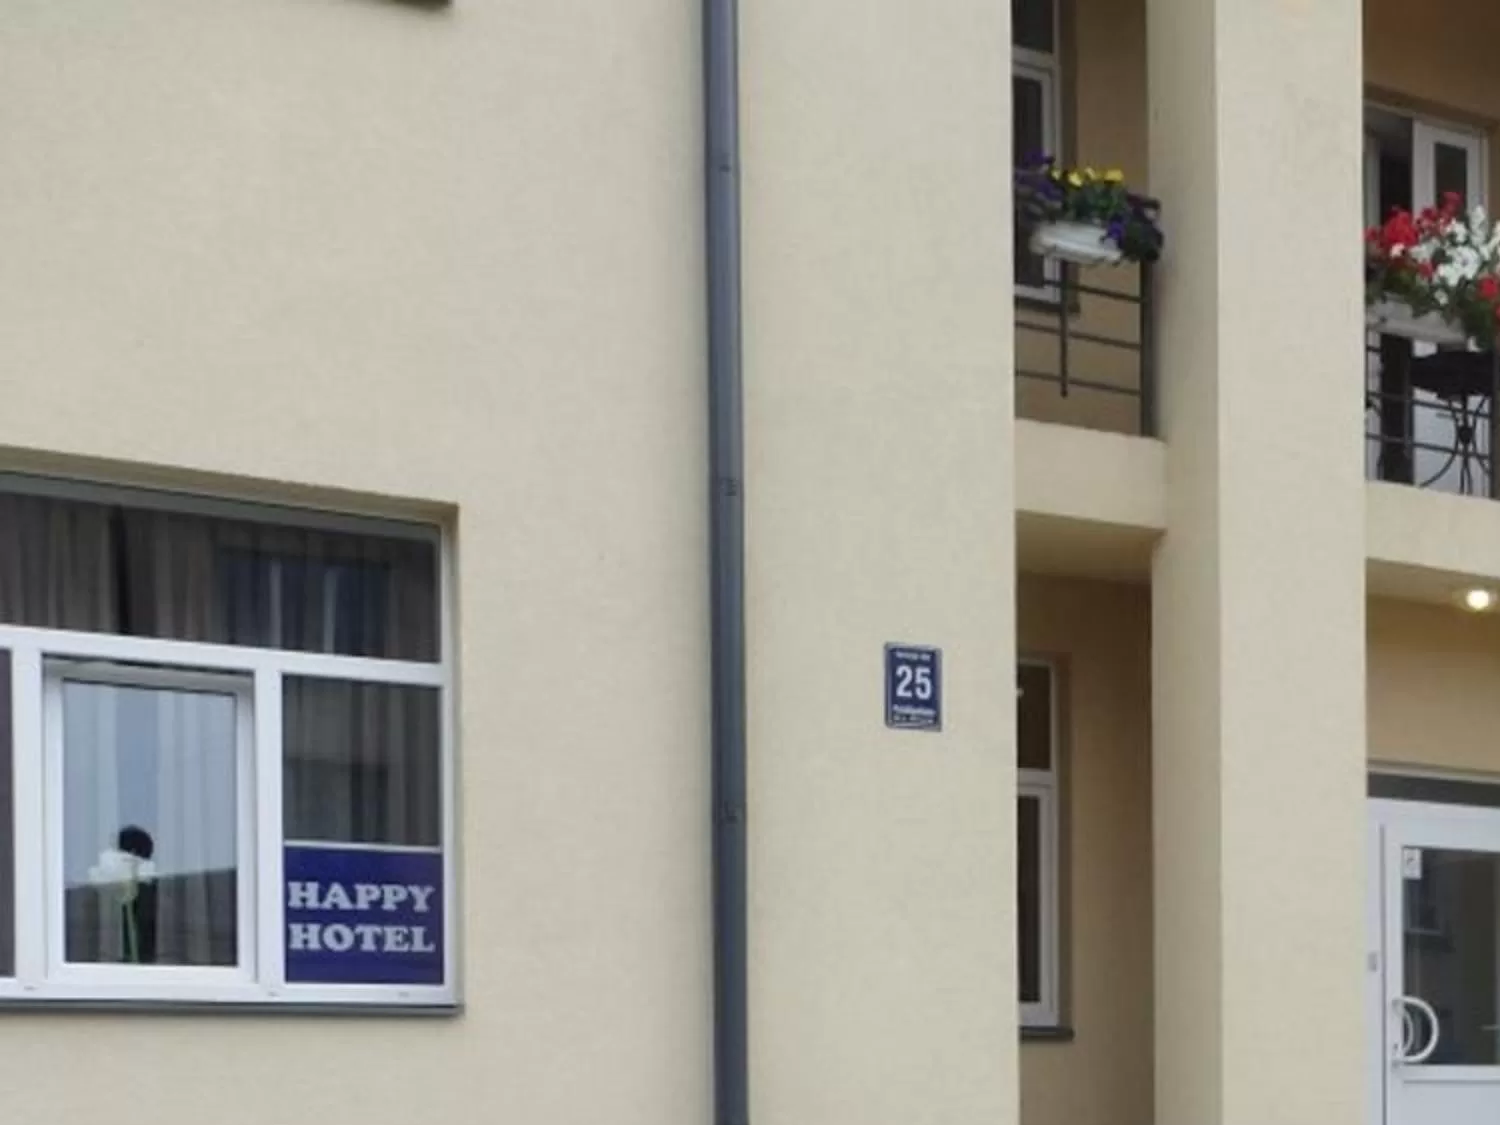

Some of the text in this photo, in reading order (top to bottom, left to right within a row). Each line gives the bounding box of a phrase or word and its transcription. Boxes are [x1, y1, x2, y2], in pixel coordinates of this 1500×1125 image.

[896, 665, 931, 700] 25
[288, 881, 435, 912] HAPPY
[288, 923, 435, 952] HOTEL
